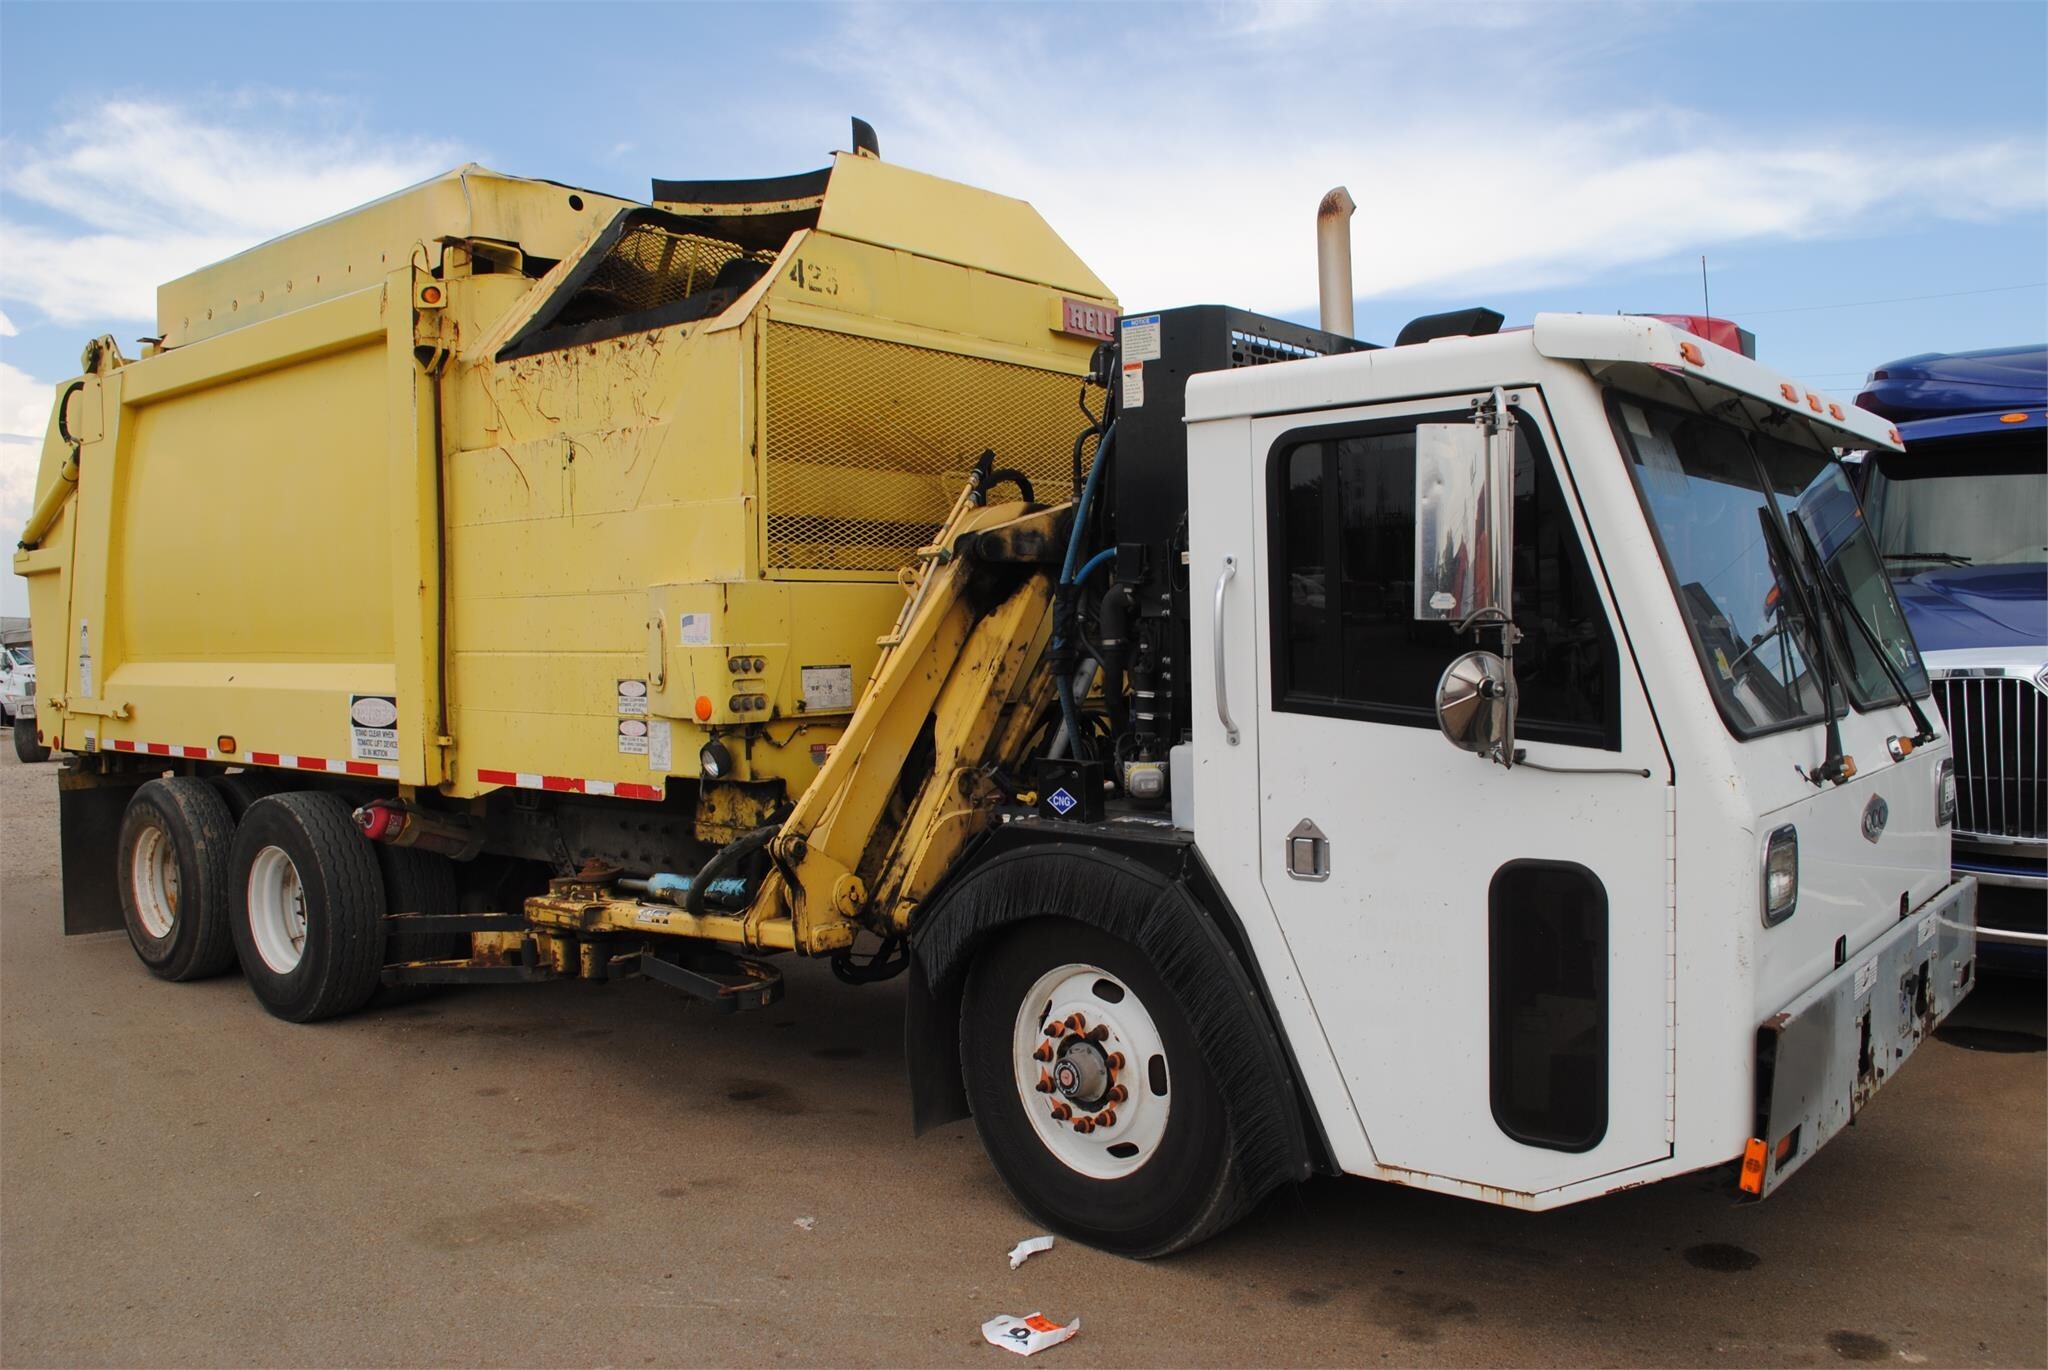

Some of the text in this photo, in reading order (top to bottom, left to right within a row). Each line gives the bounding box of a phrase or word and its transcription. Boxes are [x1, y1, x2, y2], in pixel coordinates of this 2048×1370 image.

[1069, 303, 1115, 336] HEIL
[368, 730, 381, 738] CLEAR
[382, 731, 394, 739] WHEN
[1053, 796, 1070, 807] CNG
